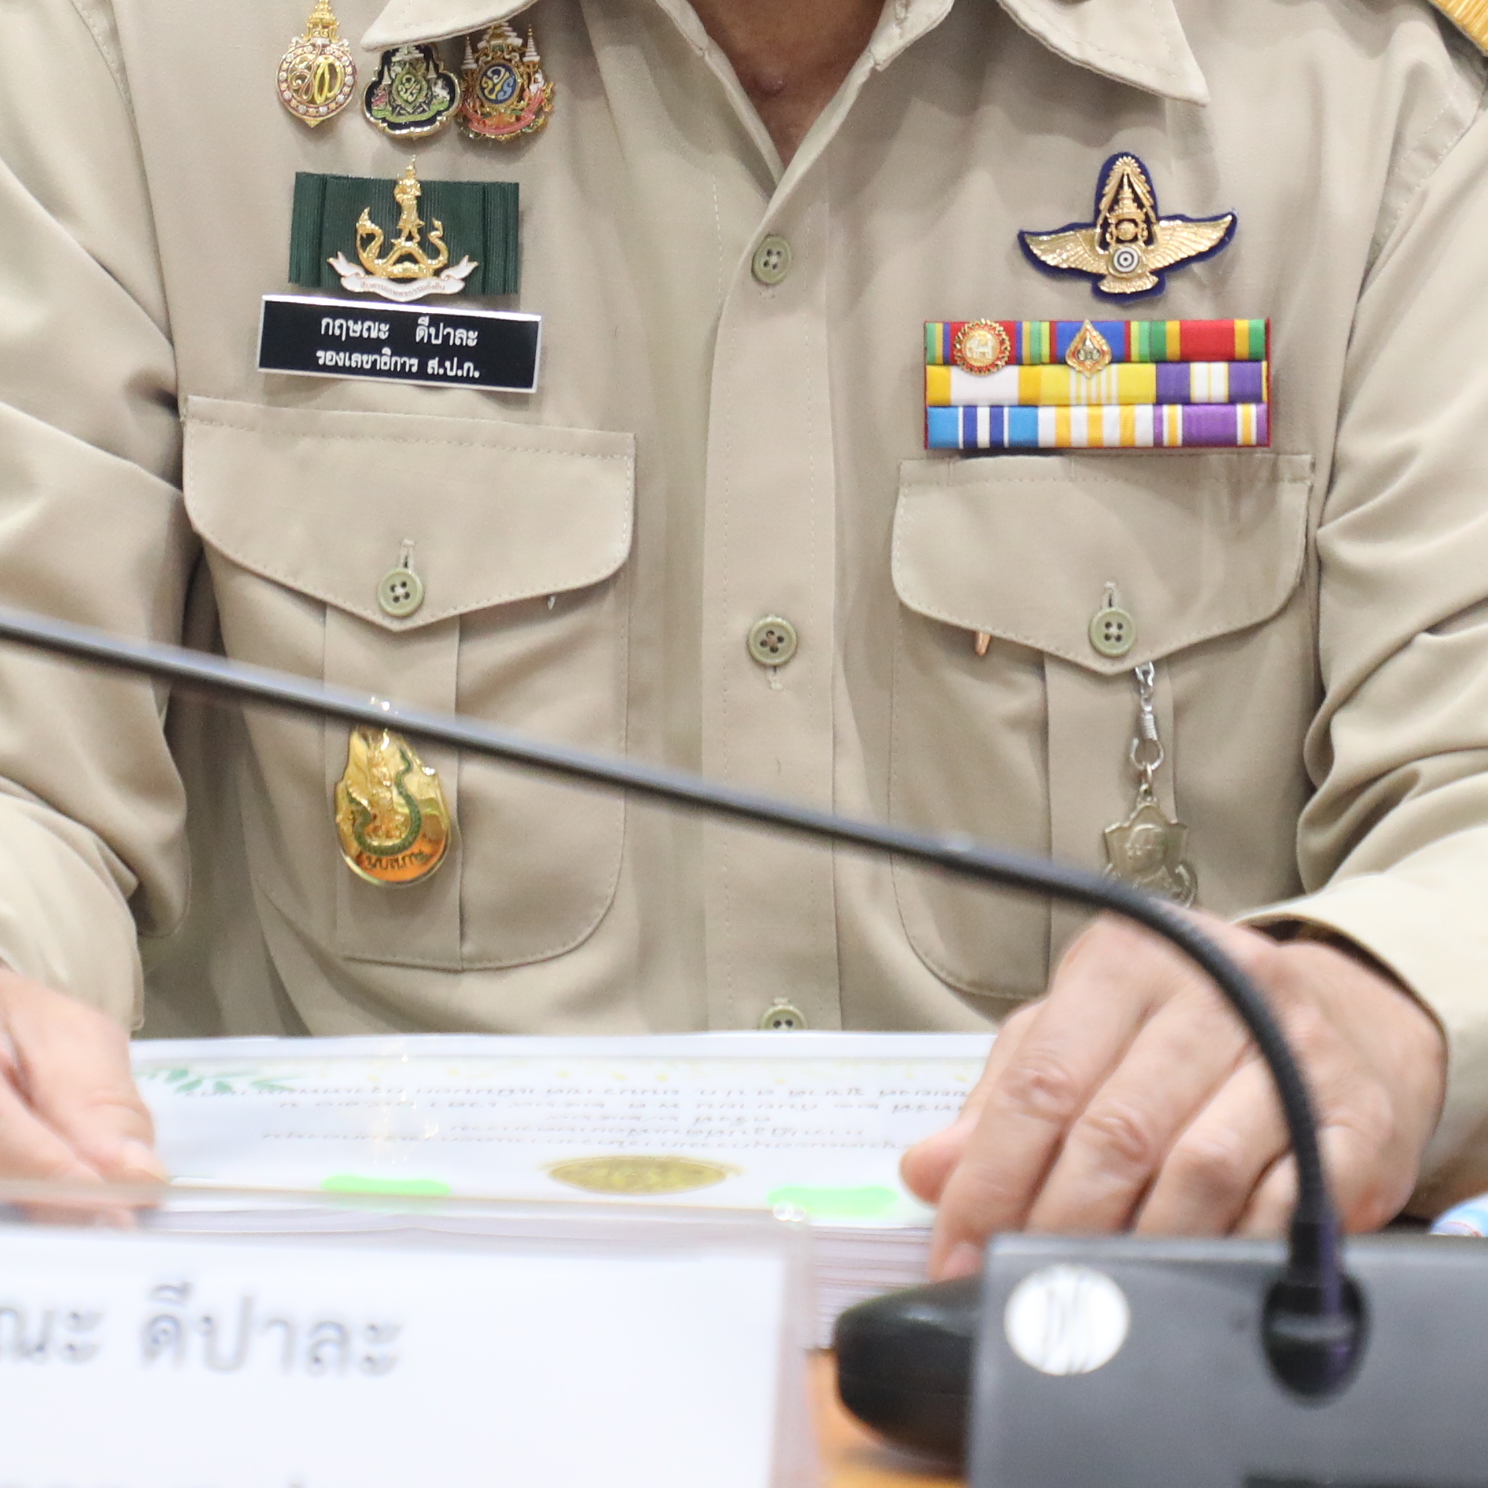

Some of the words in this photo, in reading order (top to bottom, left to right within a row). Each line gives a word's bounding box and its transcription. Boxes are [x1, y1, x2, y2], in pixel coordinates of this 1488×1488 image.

[320, 317, 390, 342] กฤษณะ
[415, 315, 479, 347] ดีปาละ
[315, 346, 419, 373] รองเลขาธิการ
[426, 356, 481, 379] ส.ป.ก.
[139, 1276, 404, 1378] ดีปาละ
